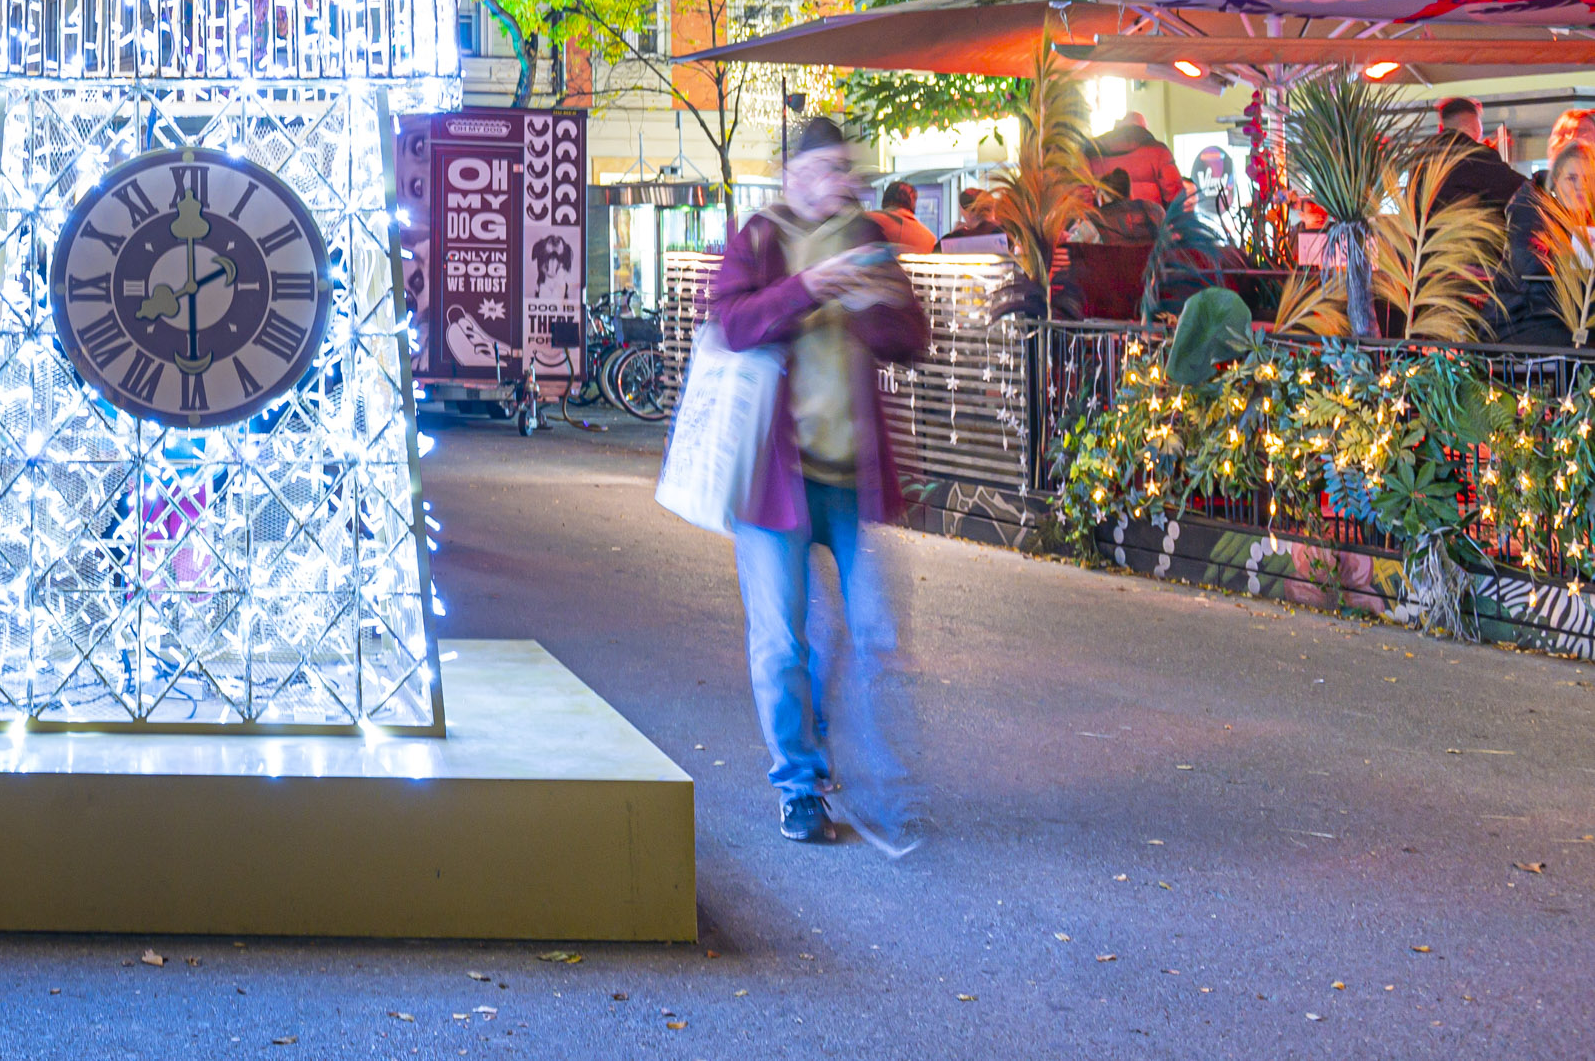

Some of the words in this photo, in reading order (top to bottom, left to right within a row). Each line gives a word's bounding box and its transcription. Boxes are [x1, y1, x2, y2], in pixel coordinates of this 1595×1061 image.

[169, 166, 210, 209] XII
[447, 157, 508, 191] OH
[111, 178, 159, 229] XI
[229, 181, 259, 221] I
[447, 192, 508, 210] MY
[80, 221, 127, 255] X
[257, 220, 303, 256] II
[447, 211, 507, 240] DOG
[447, 250, 490, 262] ONLY
[491, 250, 507, 262] IN
[447, 261, 507, 277] DOG
[68, 274, 111, 303] IX
[271, 270, 315, 303] III
[447, 276, 465, 292] WE
[469, 277, 507, 293] TRUST
[528, 303, 558, 312] DOG
[563, 304, 575, 312] IS
[77, 312, 130, 370] VIII
[118, 349, 166, 404] VII
[232, 355, 264, 398] V
